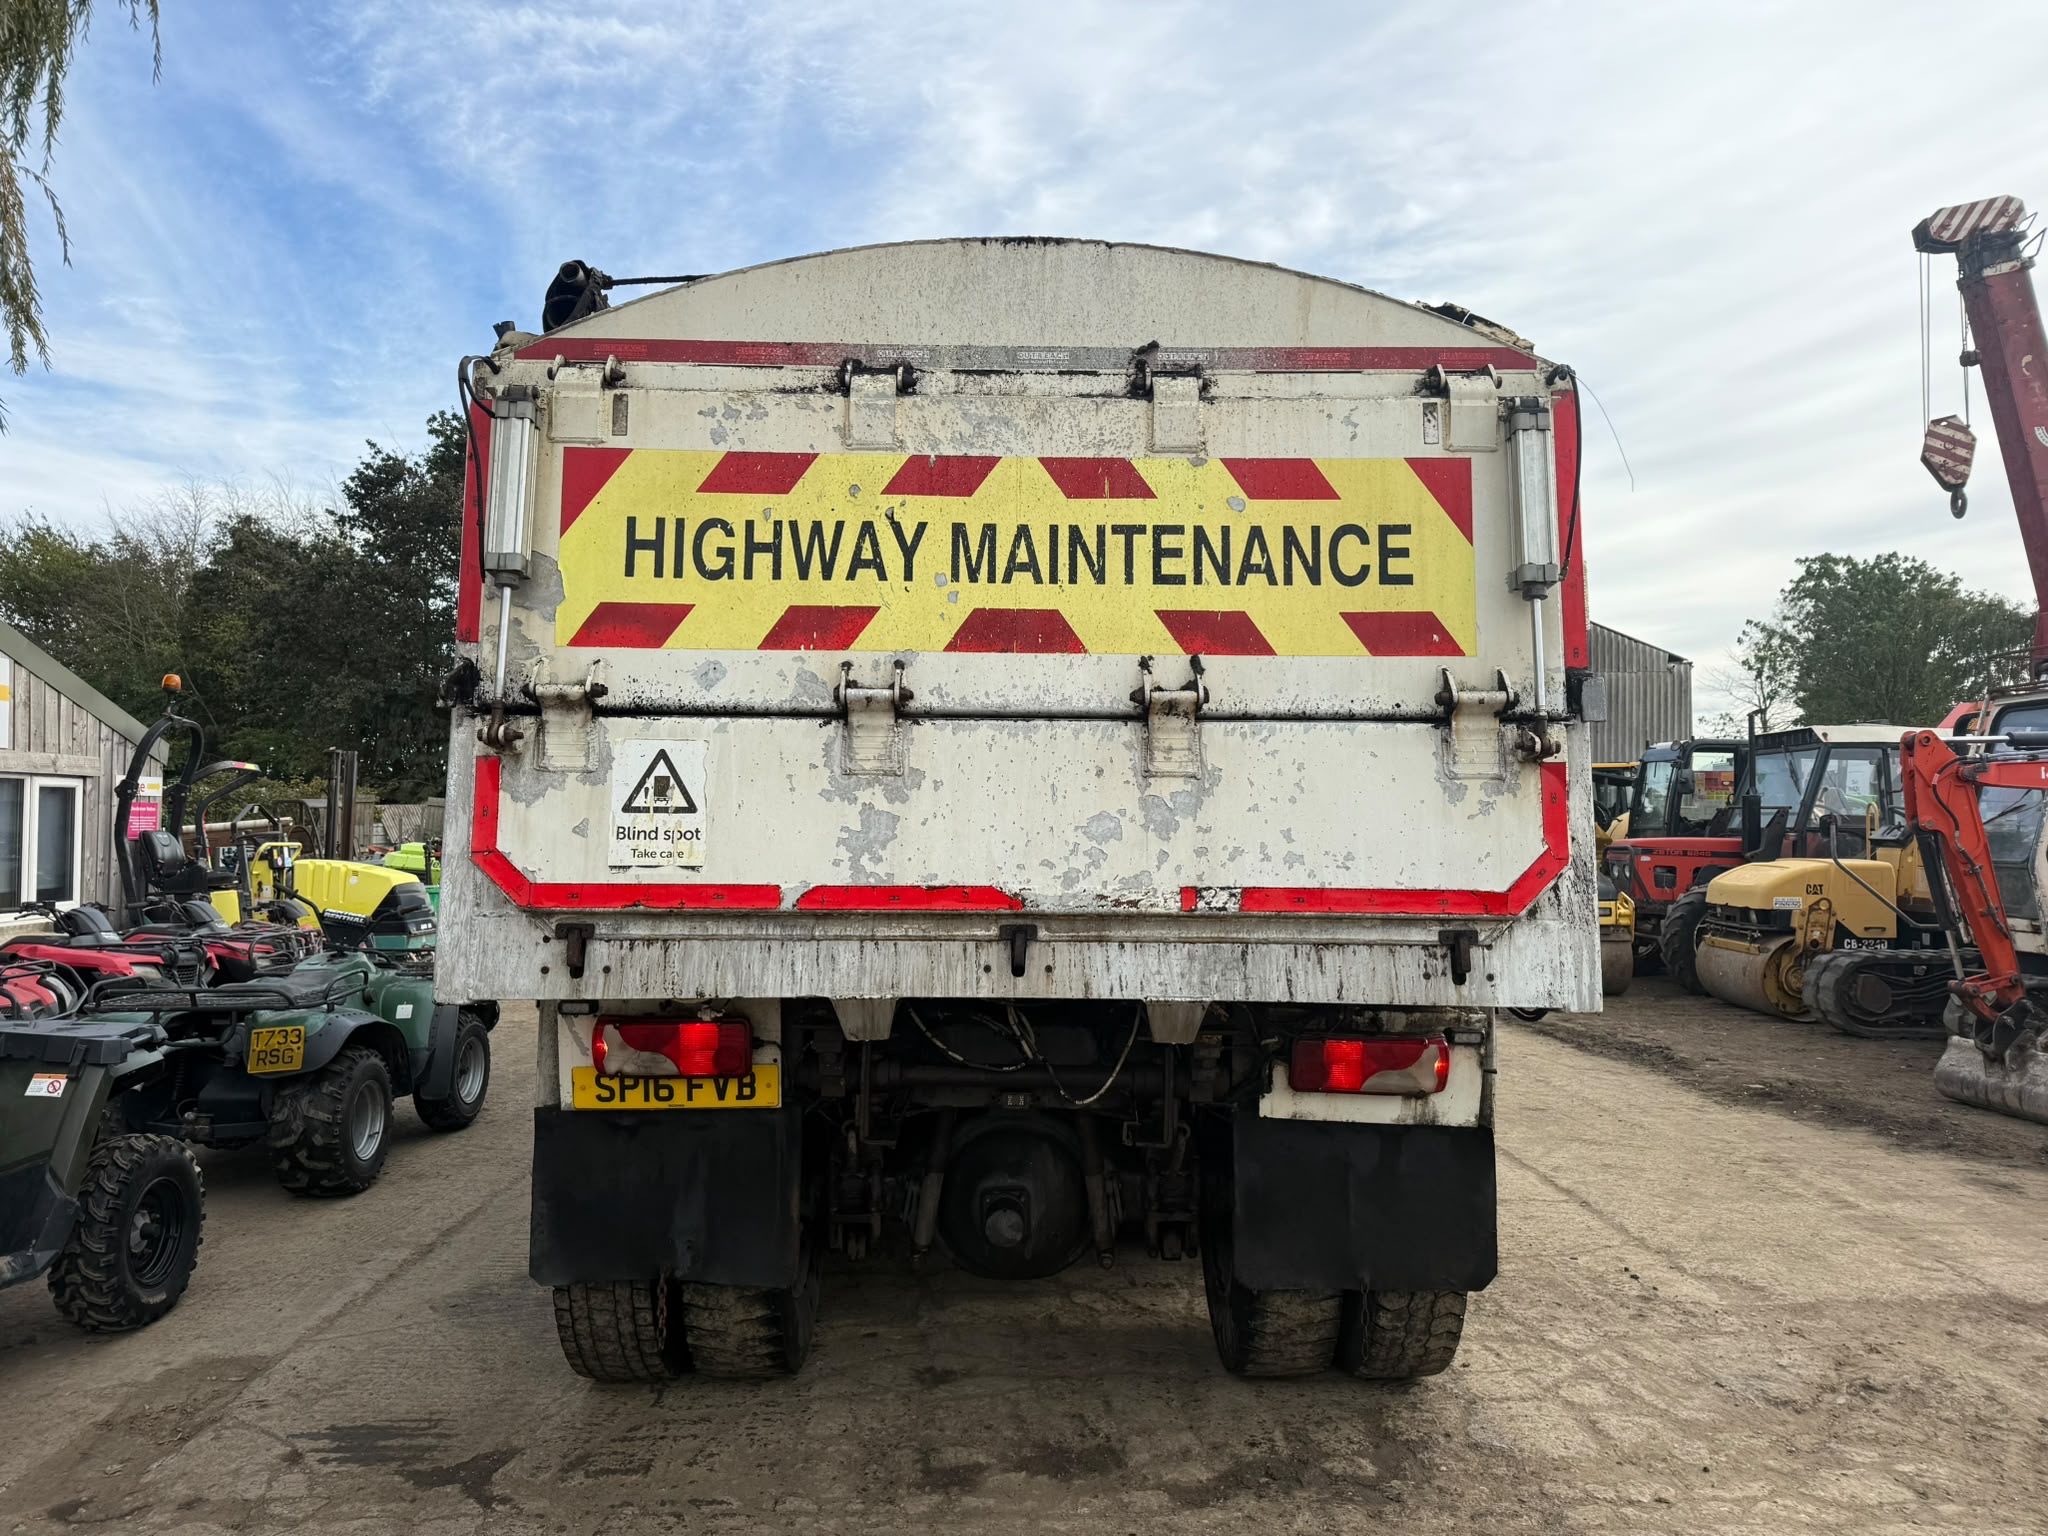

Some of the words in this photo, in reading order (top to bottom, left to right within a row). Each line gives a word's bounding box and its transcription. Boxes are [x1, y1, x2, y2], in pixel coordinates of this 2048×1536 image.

[1017, 352, 1069, 360] OUTREACH
[624, 516, 929, 582] HIGHWAY
[950, 522, 1415, 587] MAINTENANCE
[616, 826, 658, 840] Blind
[663, 827, 701, 844] spot
[631, 848, 657, 858] Take
[660, 850, 684, 858] care
[1806, 884, 1824, 895] CAT
[324, 910, 365, 923] RENTHAL
[253, 1028, 302, 1048] T733
[256, 1048, 294, 1067] RSG
[595, 1072, 675, 1103] SP16
[686, 1071, 756, 1102] FVB
